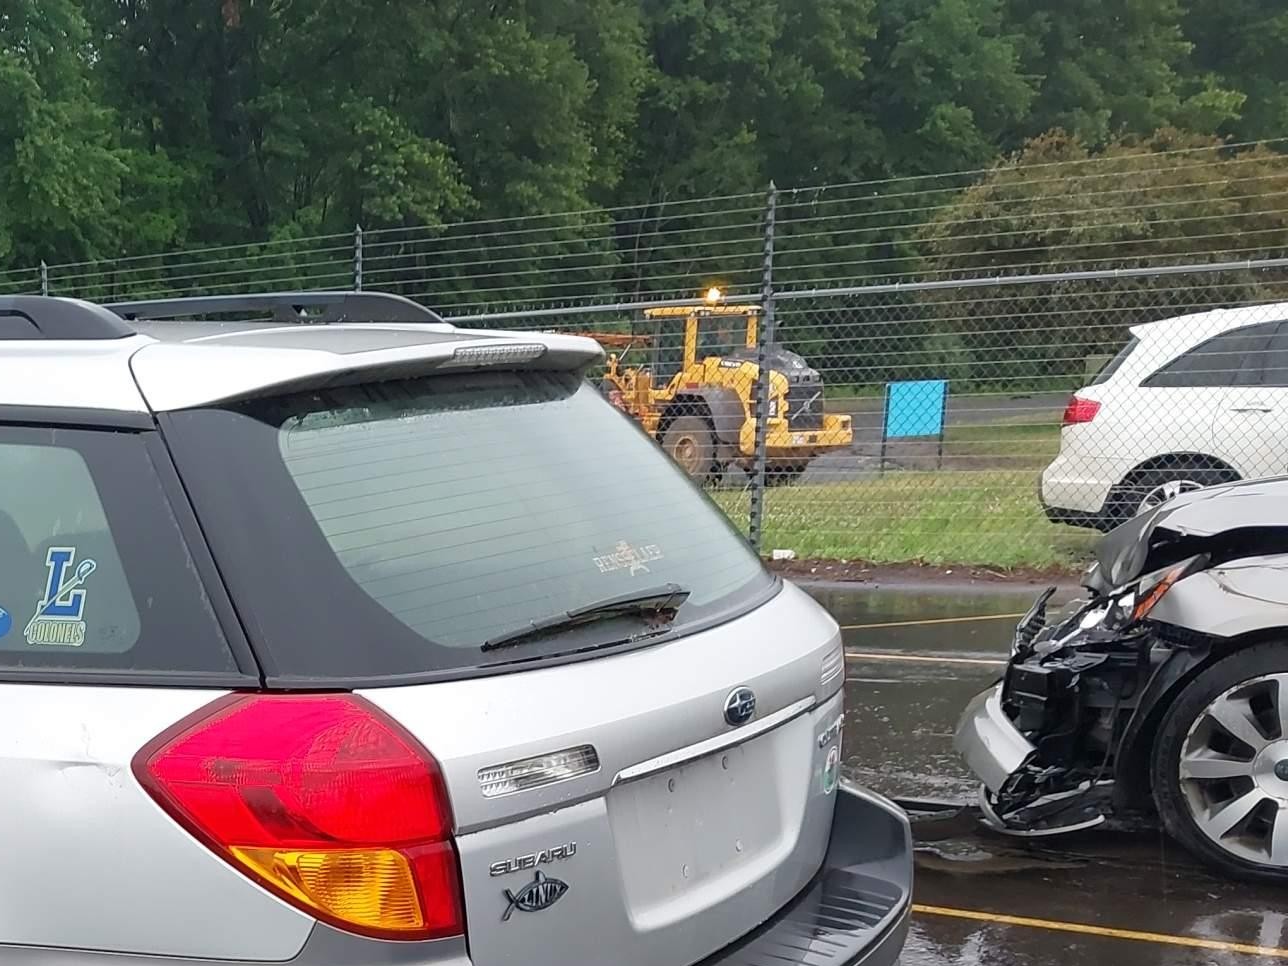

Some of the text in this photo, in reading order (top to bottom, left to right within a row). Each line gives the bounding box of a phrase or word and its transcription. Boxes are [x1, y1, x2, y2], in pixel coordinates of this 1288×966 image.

[28, 621, 86, 644] COLONELS
[489, 841, 577, 877] SUBARU
[520, 881, 566, 908] LINUX
